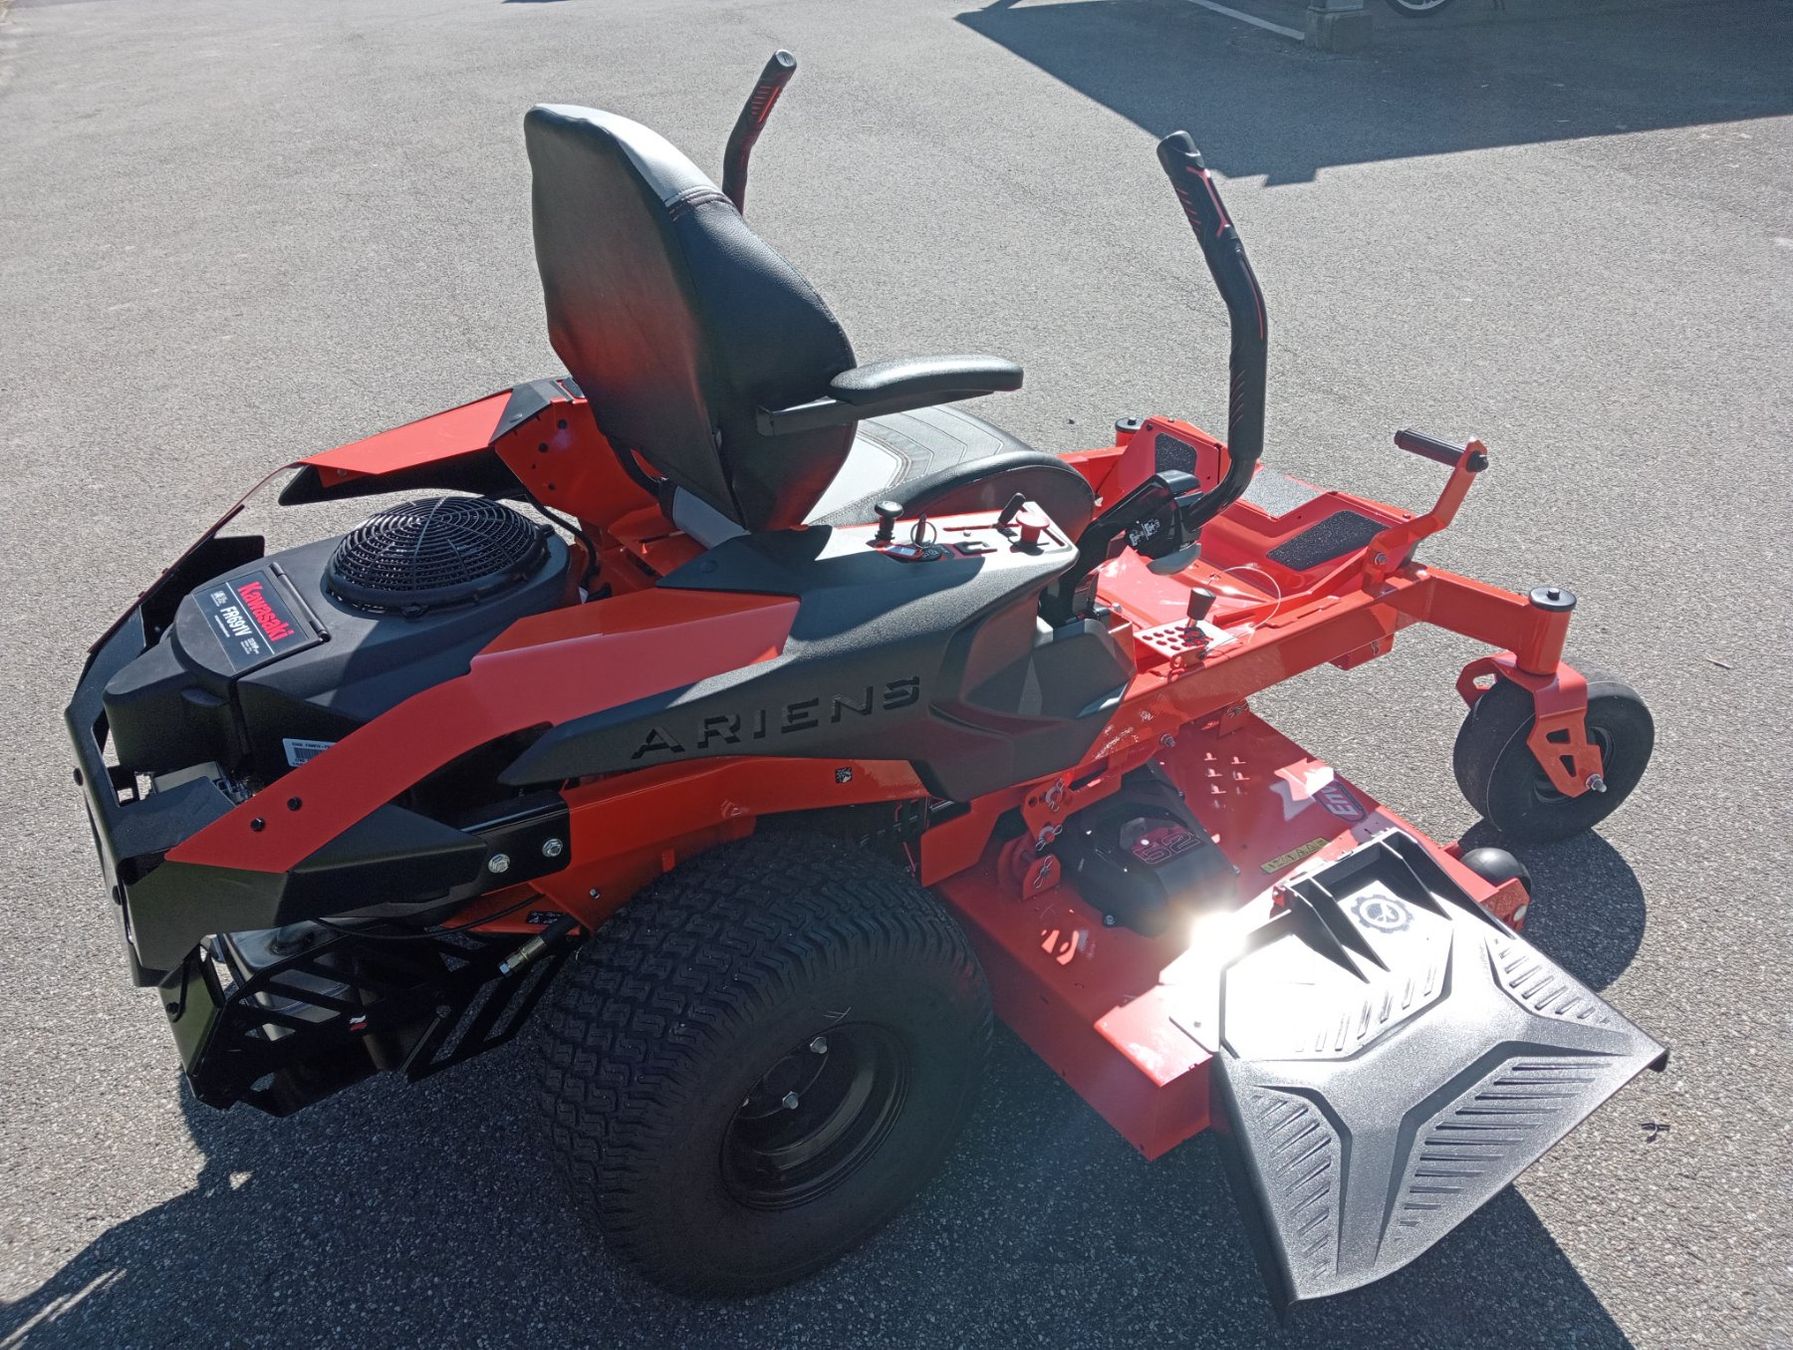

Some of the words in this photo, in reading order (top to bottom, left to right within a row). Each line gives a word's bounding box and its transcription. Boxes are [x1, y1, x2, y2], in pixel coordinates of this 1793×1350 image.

[220, 605, 253, 637] FR691V
[237, 581, 295, 642] Kawasaki
[631, 676, 920, 759] ARIENS
